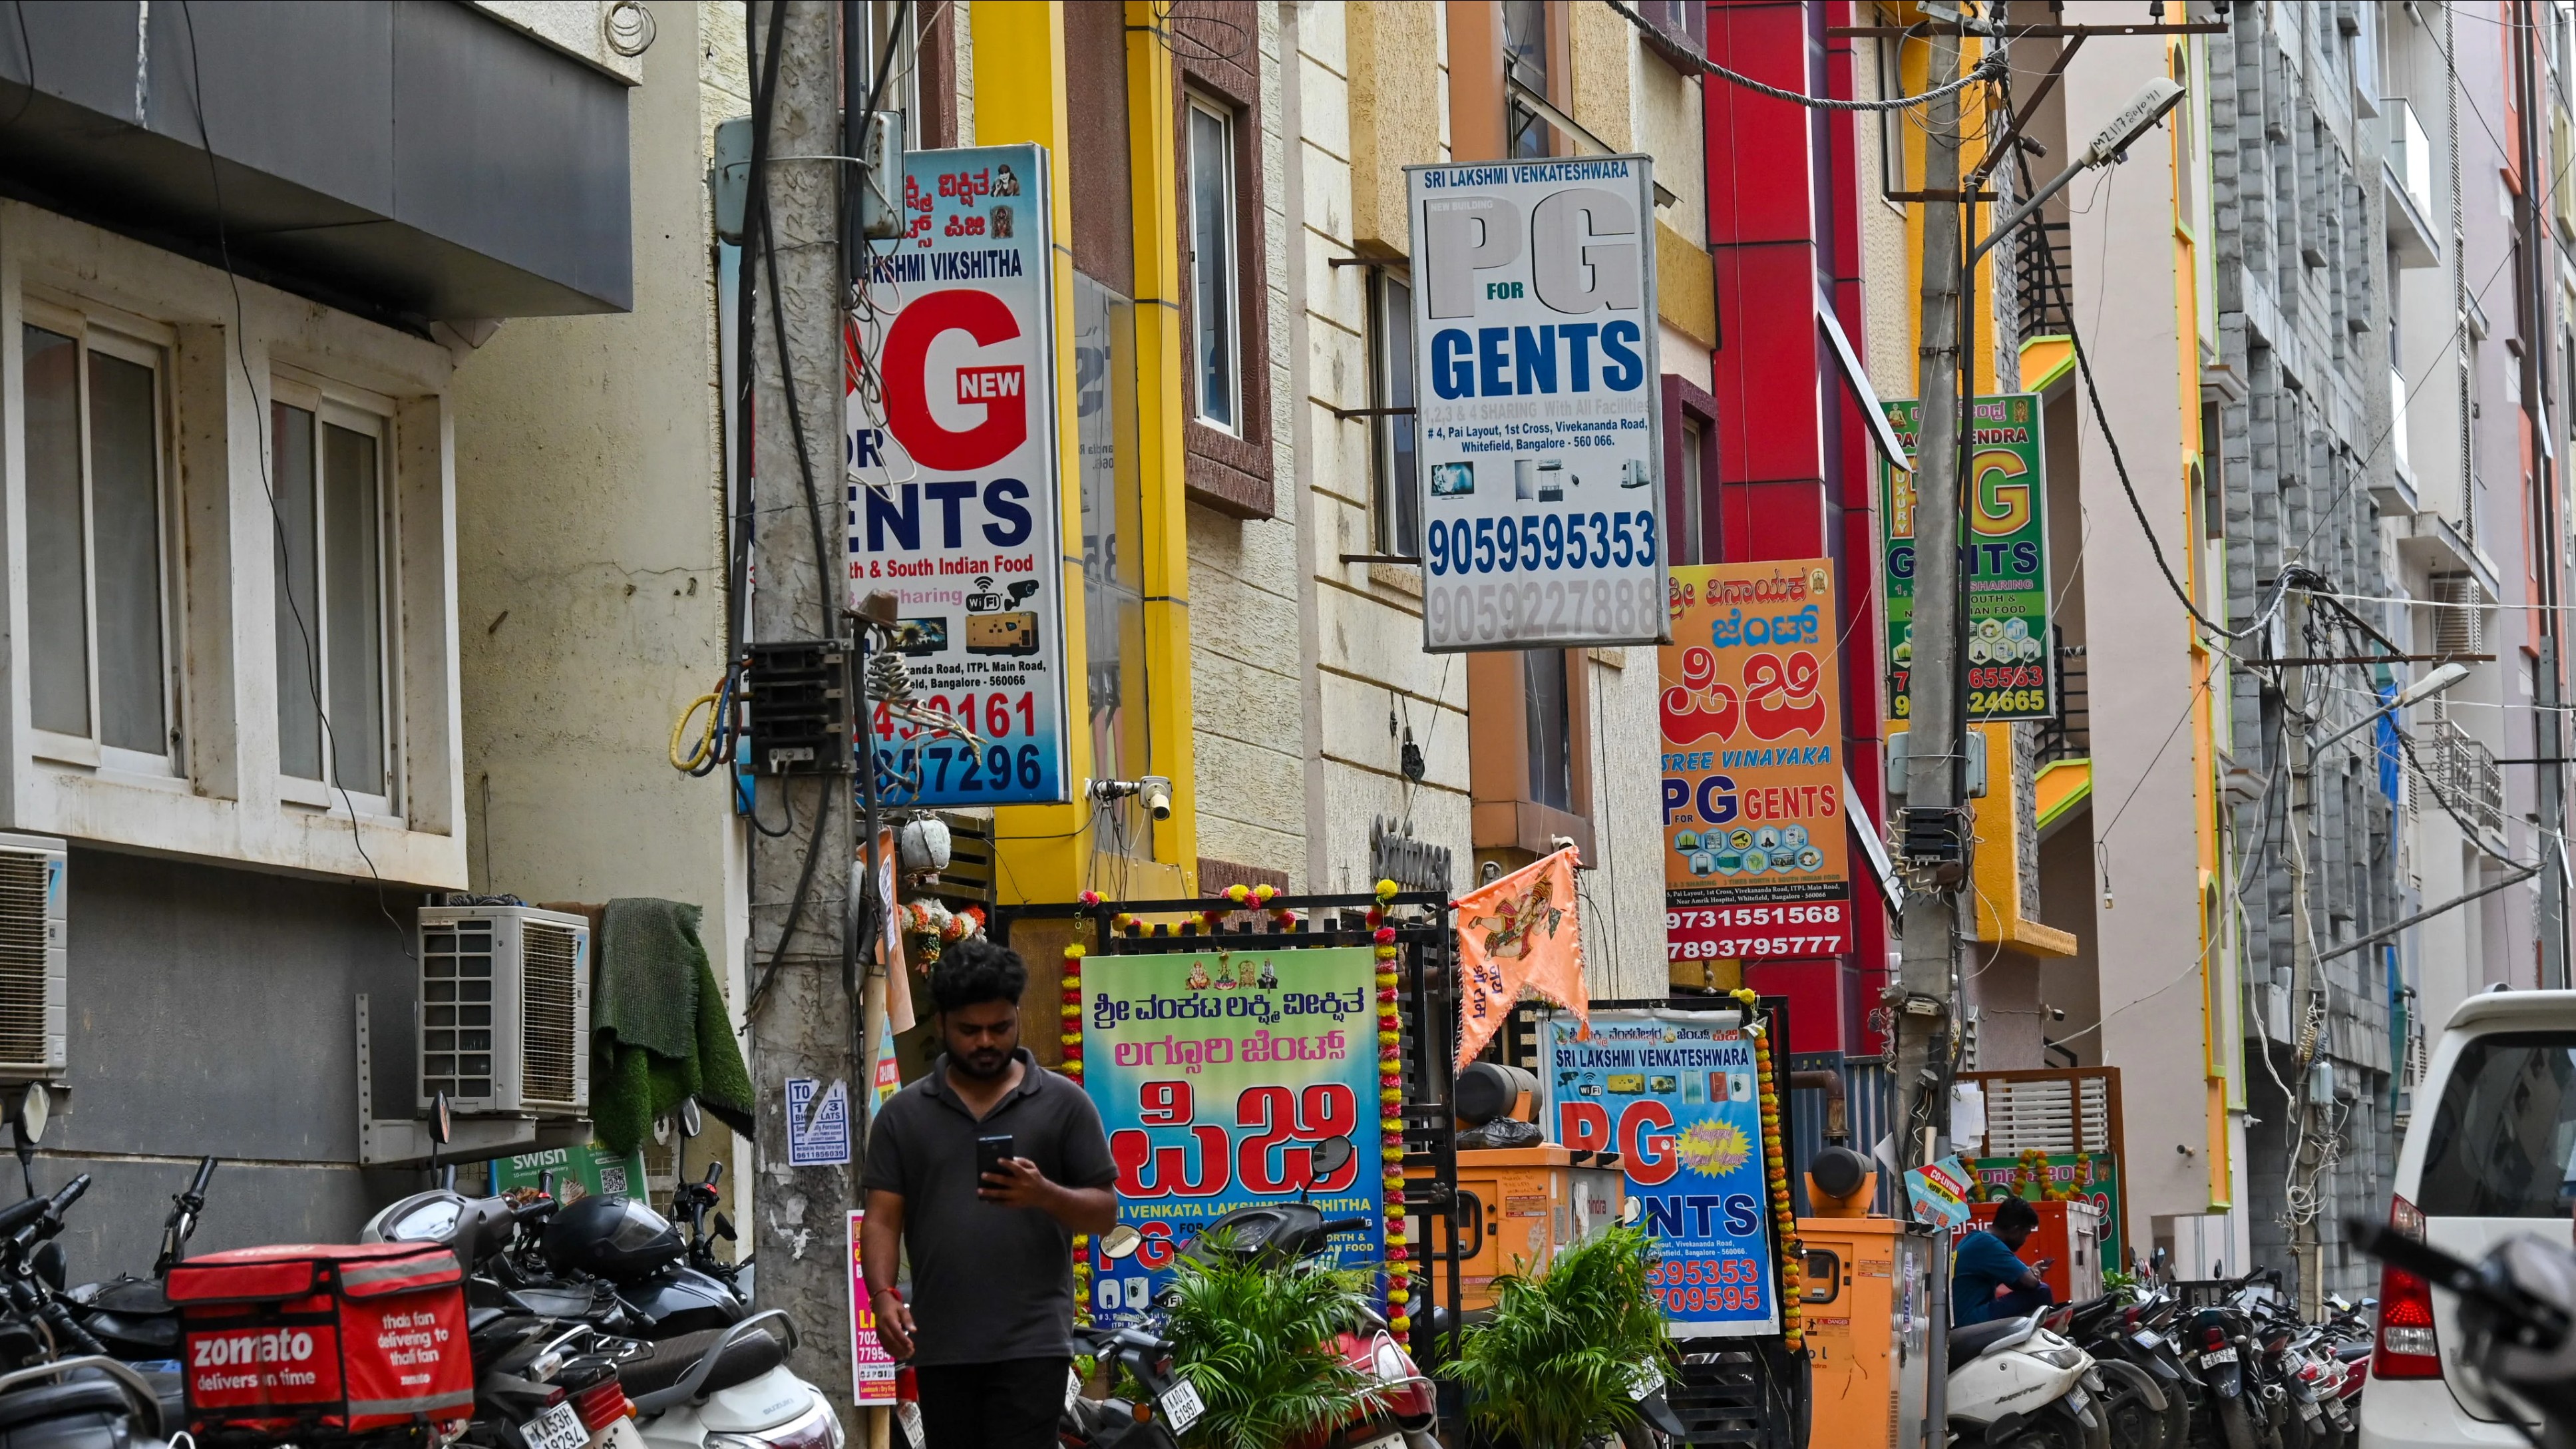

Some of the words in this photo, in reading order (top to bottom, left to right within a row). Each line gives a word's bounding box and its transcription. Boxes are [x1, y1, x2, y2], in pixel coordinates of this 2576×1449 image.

[1425, 171, 1445, 188] SRI
[1449, 168, 1507, 186] LAKSHMI
[1513, 161, 1629, 183] VENKATESHWARA
[1431, 203, 1449, 212] NEW
[1452, 200, 1493, 210] BUILDING
[933, 249, 1022, 282] VIKSHITHA
[1423, 188, 1638, 319] PG
[1487, 282, 1524, 300] FOR
[1431, 319, 1643, 400] GENTS
[846, 290, 1026, 471] G
[960, 371, 1020, 399] NEW
[1470, 405, 1477, 419] 4
[1481, 402, 1537, 420] SHARING
[1545, 401, 1572, 417] With
[1576, 399, 1591, 415] All
[1428, 429, 1434, 438] #
[1436, 428, 1445, 440] 4,
[1449, 427, 1463, 437] Pai
[1466, 424, 1501, 439] Layout,
[1505, 423, 1519, 436] 1st
[1523, 421, 1553, 435] Cross,
[1556, 420, 1618, 433] Vivekananda
[1620, 418, 1648, 431] Road,
[1462, 439, 1513, 453] Whitefield,
[1517, 437, 1564, 451] Bangalore
[1574, 436, 1590, 448] 560
[1594, 435, 1614, 447] 066.
[849, 478, 1033, 553] NTS
[1429, 510, 1655, 576] 9059595353
[870, 560, 881, 578] &
[887, 559, 934, 578] South
[939, 556, 989, 574] Indian
[994, 554, 1033, 572] Food
[889, 588, 962, 606] haring
[1706, 566, 1807, 606] ವಿನಾಯಕ
[1970, 579, 2034, 591] SHARING
[1431, 577, 1657, 643] 9059227888
[1970, 606, 1990, 615] IAN
[1995, 605, 2026, 614] FOOD
[936, 664, 964, 676] Road,
[967, 662, 989, 673] ITPL
[992, 662, 1017, 672] Main
[1019, 661, 1046, 672] Road,
[931, 678, 980, 690] Bangalore
[990, 675, 1025, 686] 560066
[1659, 646, 1826, 746] ಪಿಜಿ
[1661, 751, 1714, 773] SREE
[1722, 746, 1831, 769] VINAYAKA
[1662, 775, 1738, 827] PG
[1744, 784, 1837, 821] GENTS
[1675, 815, 1694, 823] FOR
[1667, 905, 1840, 929] 9731551568
[1668, 936, 1841, 959] 7893795777
[1556, 1051, 1576, 1067] SRI
[1580, 1049, 1634, 1066] LAKSHMI
[1639, 1048, 1749, 1067] VENKATESHWARA
[794, 1085, 810, 1099] TO
[1109, 1080, 1359, 1199] ಪಿಜಿ
[1690, 1125, 1736, 1148] Happy
[1680, 1151, 1713, 1167] New
[1714, 1149, 1748, 1166] Year
[1928, 1183, 1942, 1194] NOW
[1942, 1191, 1954, 1203] OPEN
[1931, 1169, 1960, 1195] CO-LIVING
[1129, 1203, 1202, 1219] VENKATA
[1638, 1193, 1759, 1238] NTS
[1179, 1223, 1204, 1233] FOR
[194, 1328, 313, 1367] zomato
[435, 1329, 449, 1342] to
[198, 1372, 258, 1390] delivers
[279, 1368, 316, 1386] time
[763, 1398, 794, 1416] SUZUKI
[1167, 1384, 1191, 1410] KA01K
[1175, 1399, 1197, 1424] G1997
[532, 1407, 574, 1442] KA53H
